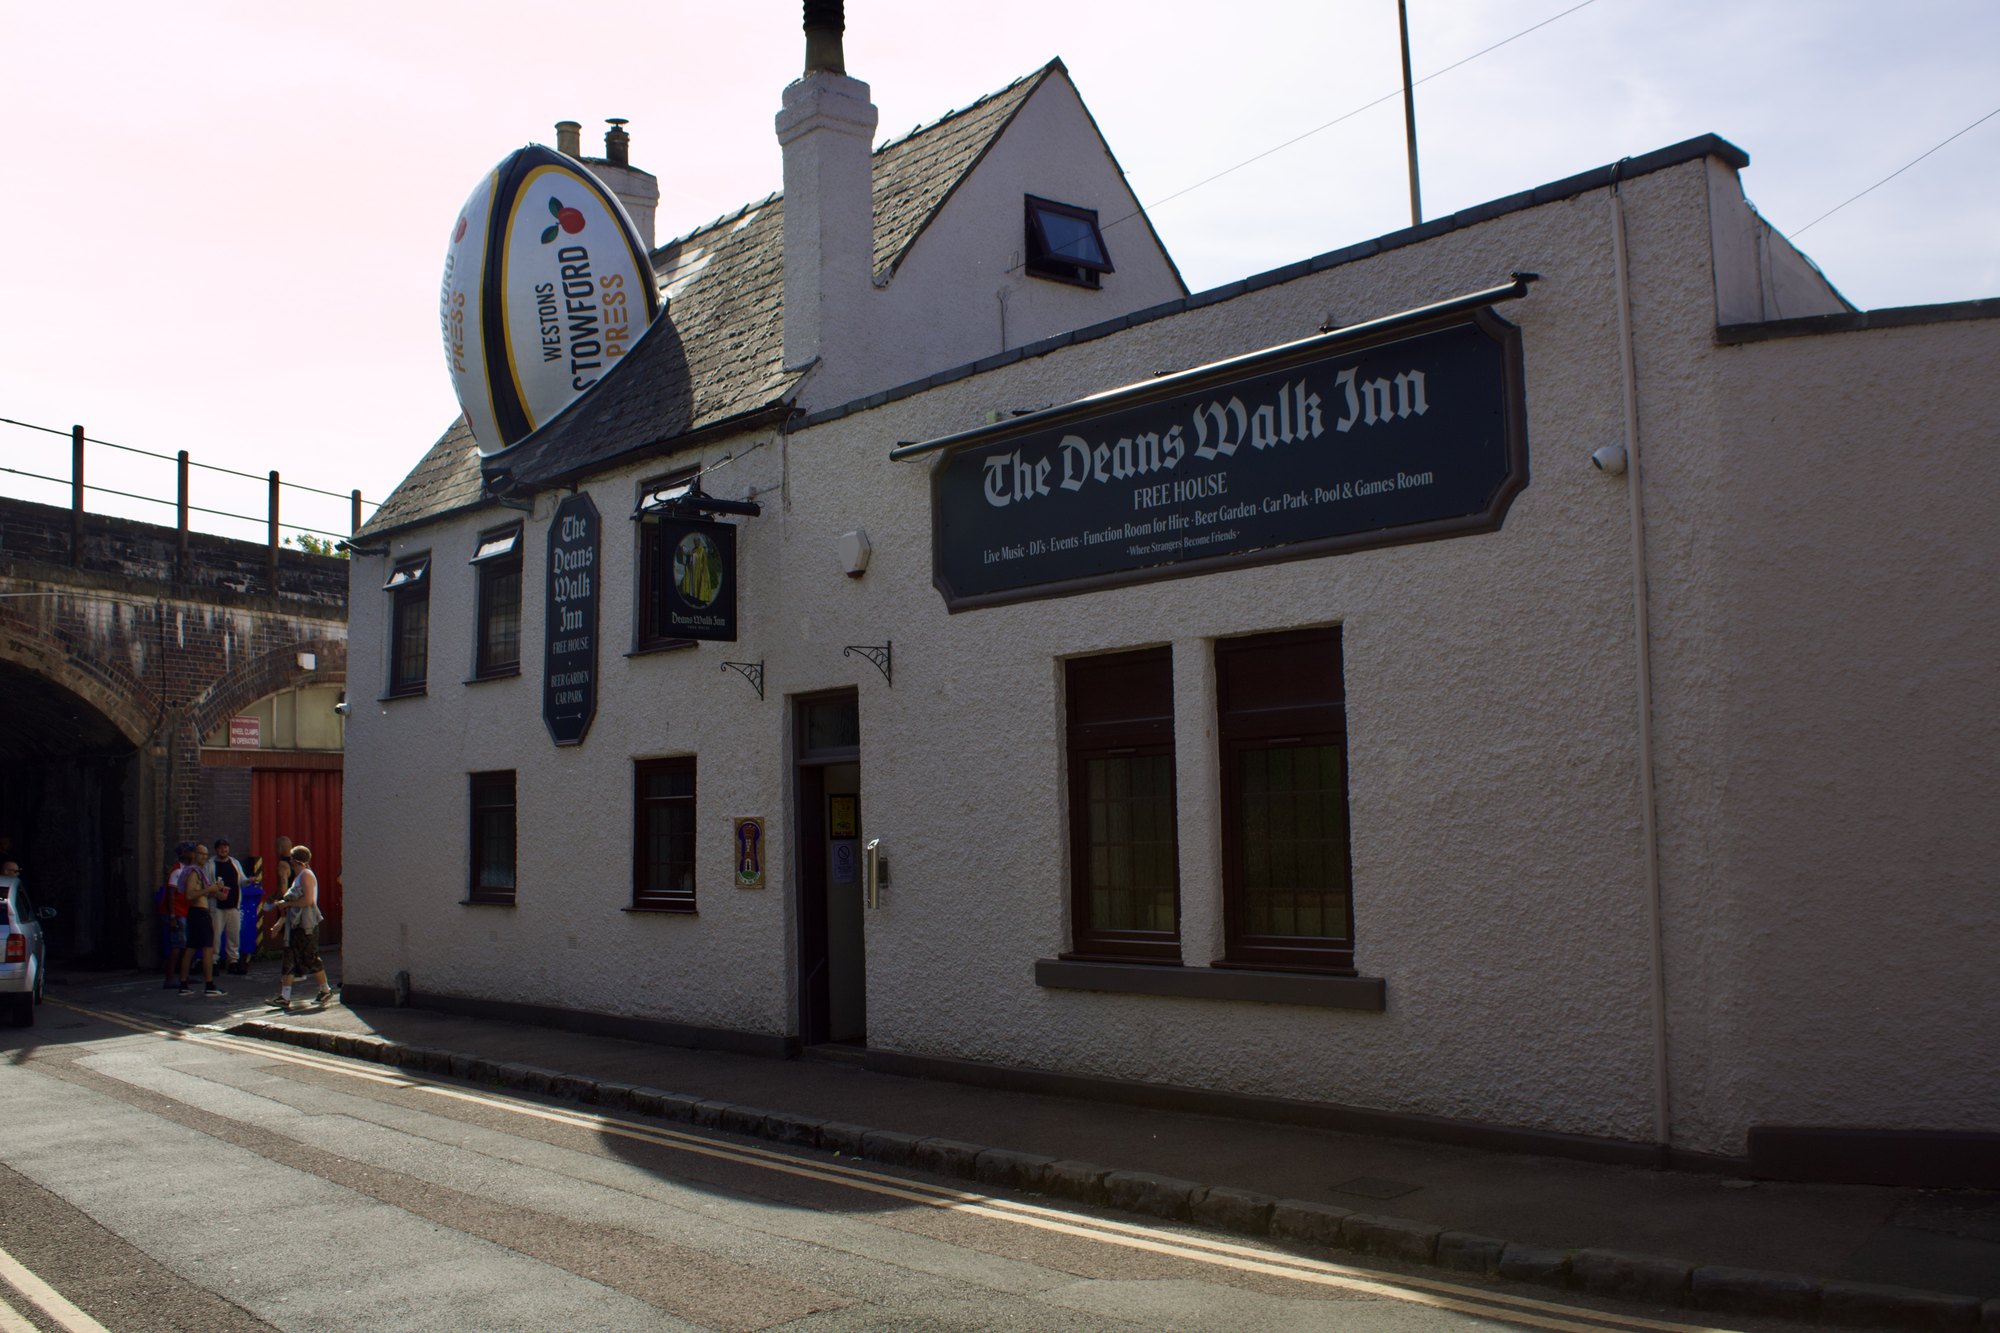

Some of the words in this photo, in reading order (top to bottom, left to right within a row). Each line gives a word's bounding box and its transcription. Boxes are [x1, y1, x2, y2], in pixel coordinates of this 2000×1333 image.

[535, 282, 562, 363] WESTONS
[558, 246, 602, 392] STOWFORD
[600, 274, 632, 358] PRESS
[452, 290, 466, 374] PRESS
[982, 448, 1051, 507] The
[1058, 424, 1185, 492] Deans
[1193, 378, 1325, 461] Walk
[1335, 366, 1430, 433] Inn
[1134, 483, 1171, 510] FREE
[1174, 472, 1228, 503] HOUSE
[562, 514, 586, 542] The
[984, 549, 1000, 564] Live
[1002, 544, 1025, 561] Music
[1029, 540, 1046, 555] DJ's
[1050, 536, 1079, 552] Events
[1084, 527, 1122, 546] Function
[1124, 522, 1151, 538] Room
[1153, 517, 1167, 532] for
[1168, 513, 1189, 530] Hire
[1195, 510, 1217, 527] Beer
[1219, 502, 1256, 521] Garden
[1263, 497, 1280, 514] Car
[1283, 491, 1308, 509] Park
[1315, 487, 1340, 504] Pool
[1342, 484, 1353, 499] &
[1354, 479, 1394, 497] Games
[1397, 471, 1433, 490] Room
[553, 546, 593, 574] Deans
[1151, 541, 1182, 554] Strangers
[1184, 537, 1209, 549] Become
[554, 571, 591, 603] Walk
[560, 605, 583, 632] Inn
[672, 611, 693, 624] Deans
[553, 640, 567, 655] FREE
[568, 636, 589, 651] HOUSE
[551, 673, 565, 687] BEER
[566, 670, 589, 686] GARDEN
[555, 692, 566, 705] CAR
[568, 690, 583, 703] PARK
